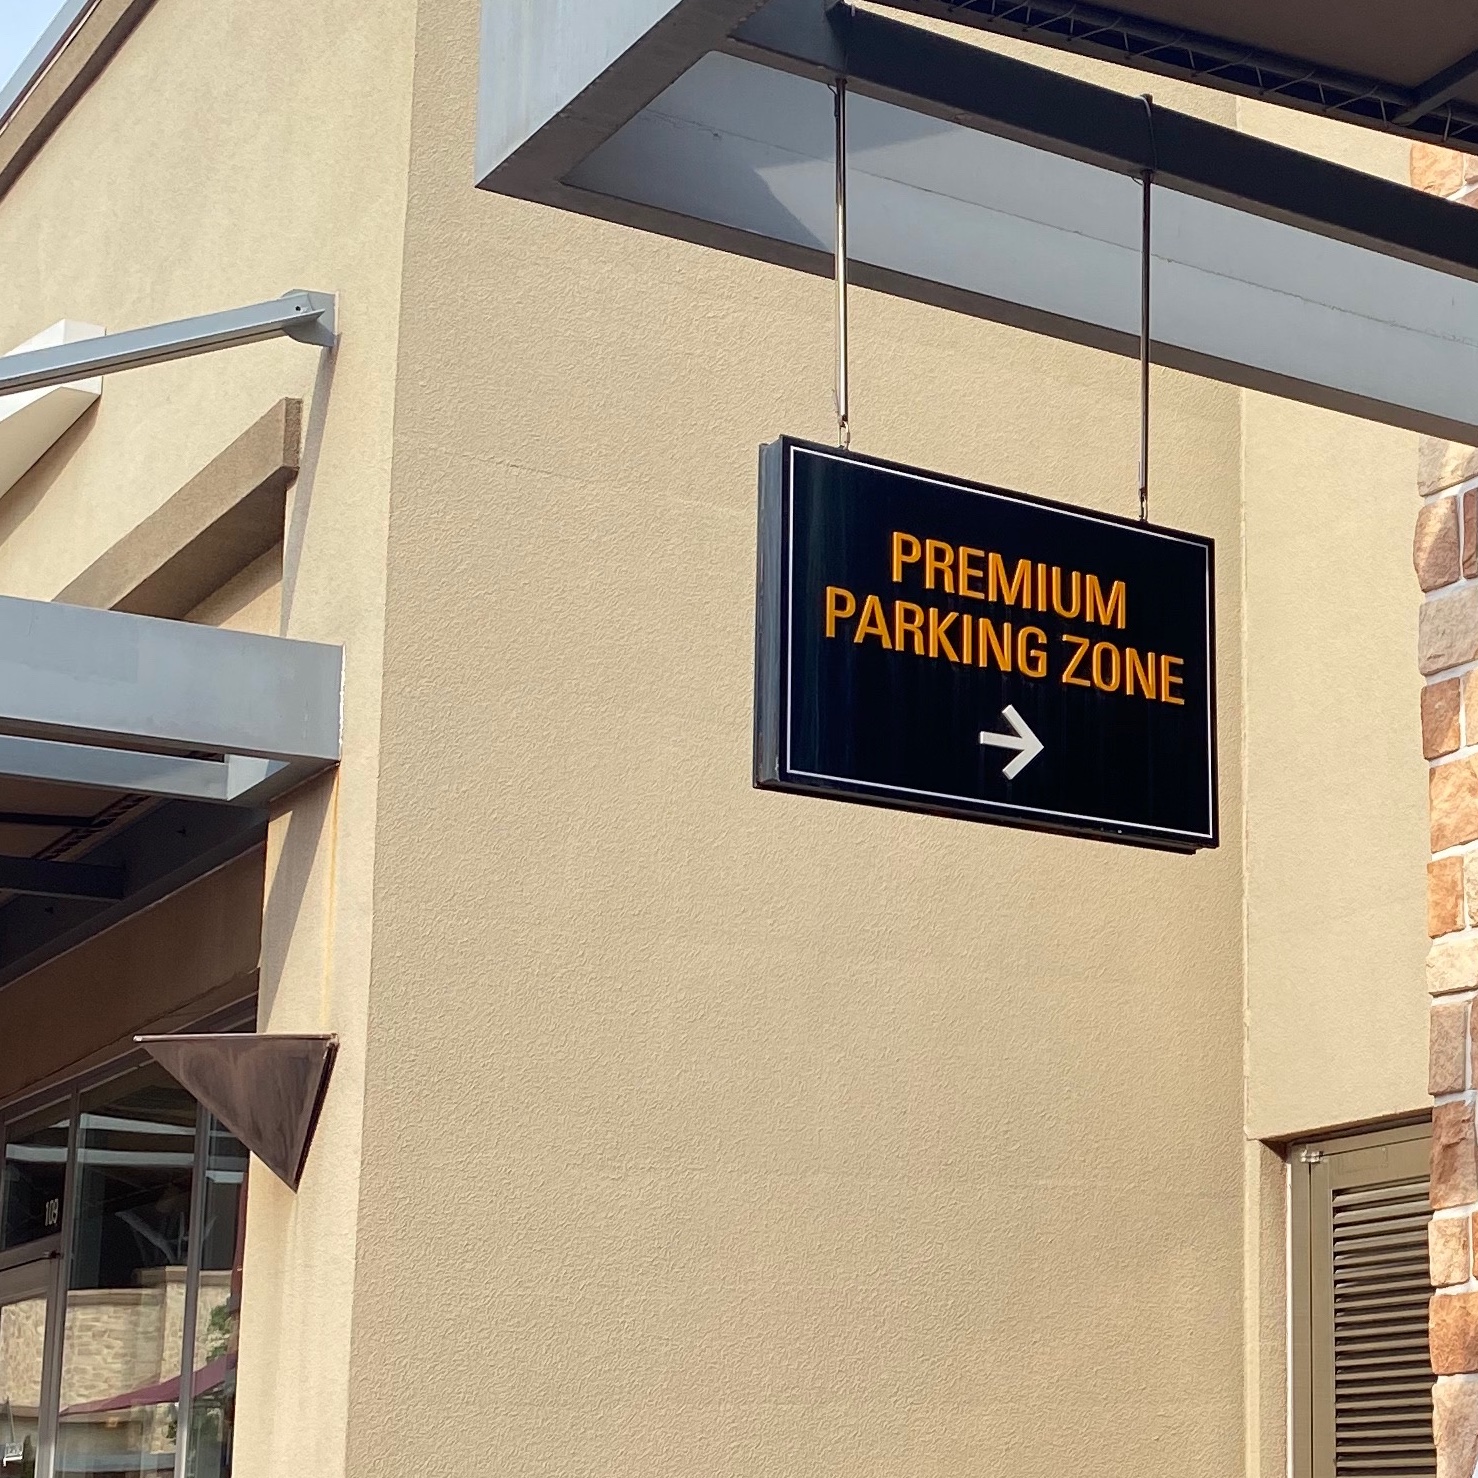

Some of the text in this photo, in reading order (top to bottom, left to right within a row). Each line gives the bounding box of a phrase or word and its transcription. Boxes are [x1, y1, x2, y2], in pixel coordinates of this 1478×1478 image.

[891, 531, 1127, 629] PREMIUM
[825, 585, 1185, 704] PARKING ZONE
[45, 1198, 59, 1227] 109
